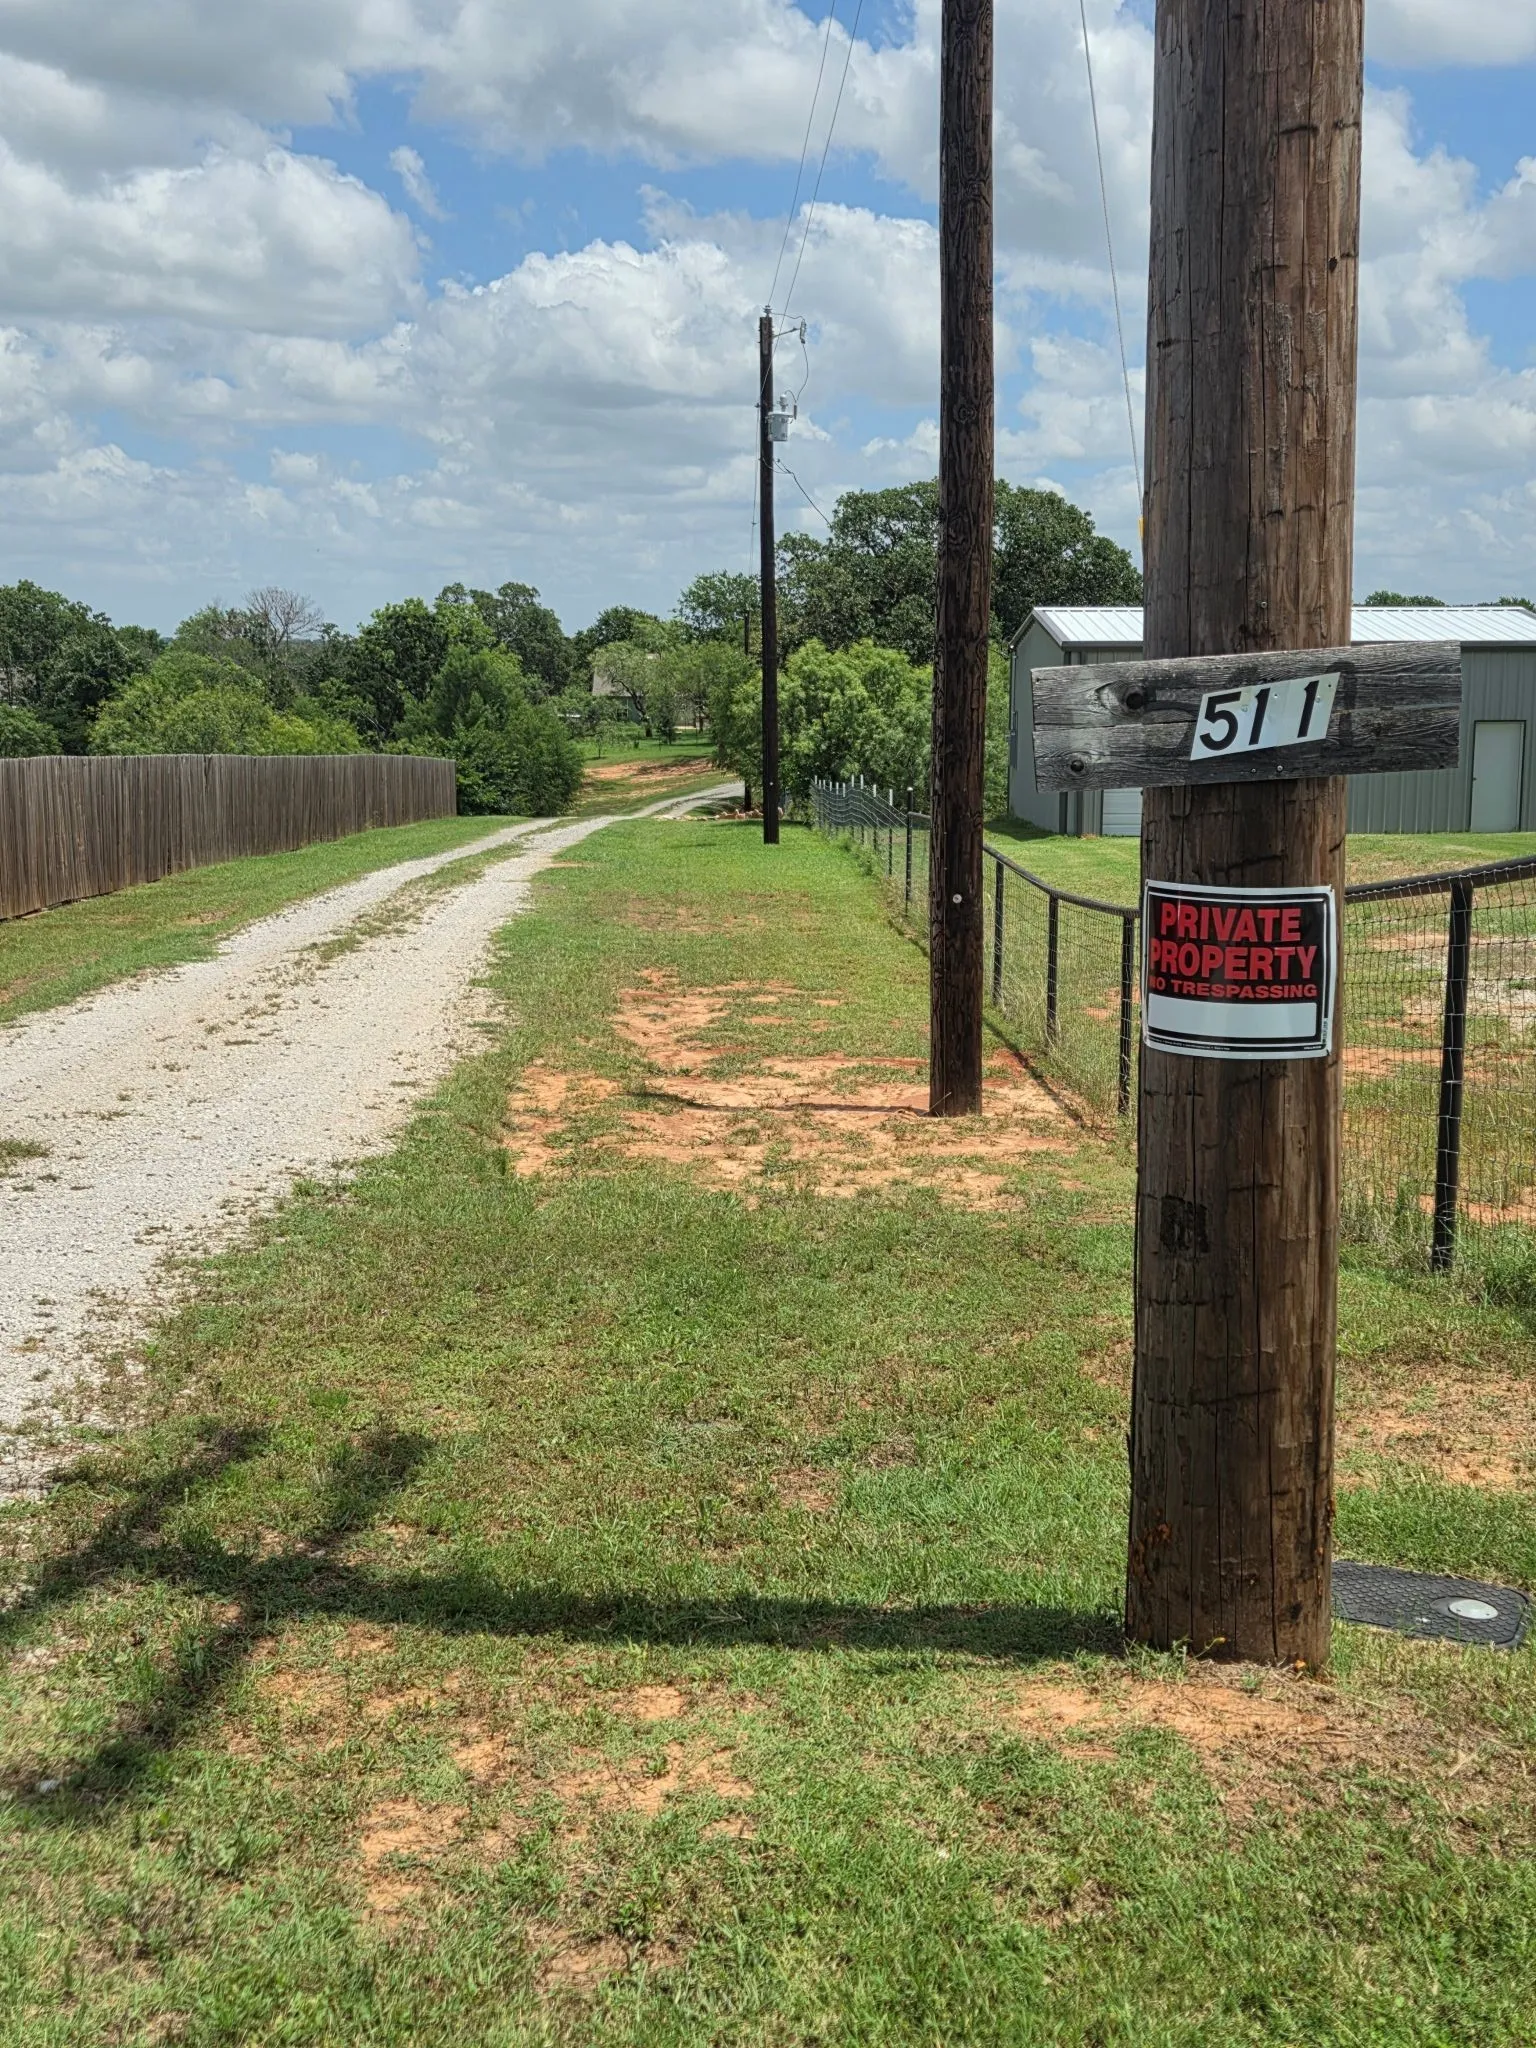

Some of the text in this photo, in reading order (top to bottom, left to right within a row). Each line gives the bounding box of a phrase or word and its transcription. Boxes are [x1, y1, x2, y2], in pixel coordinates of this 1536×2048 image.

[1199, 680, 1320, 751] 511
[1160, 902, 1301, 942] PRIVATE
[1150, 938, 1317, 980] PROPERTY
[1171, 979, 1317, 999] TRESPASSING
